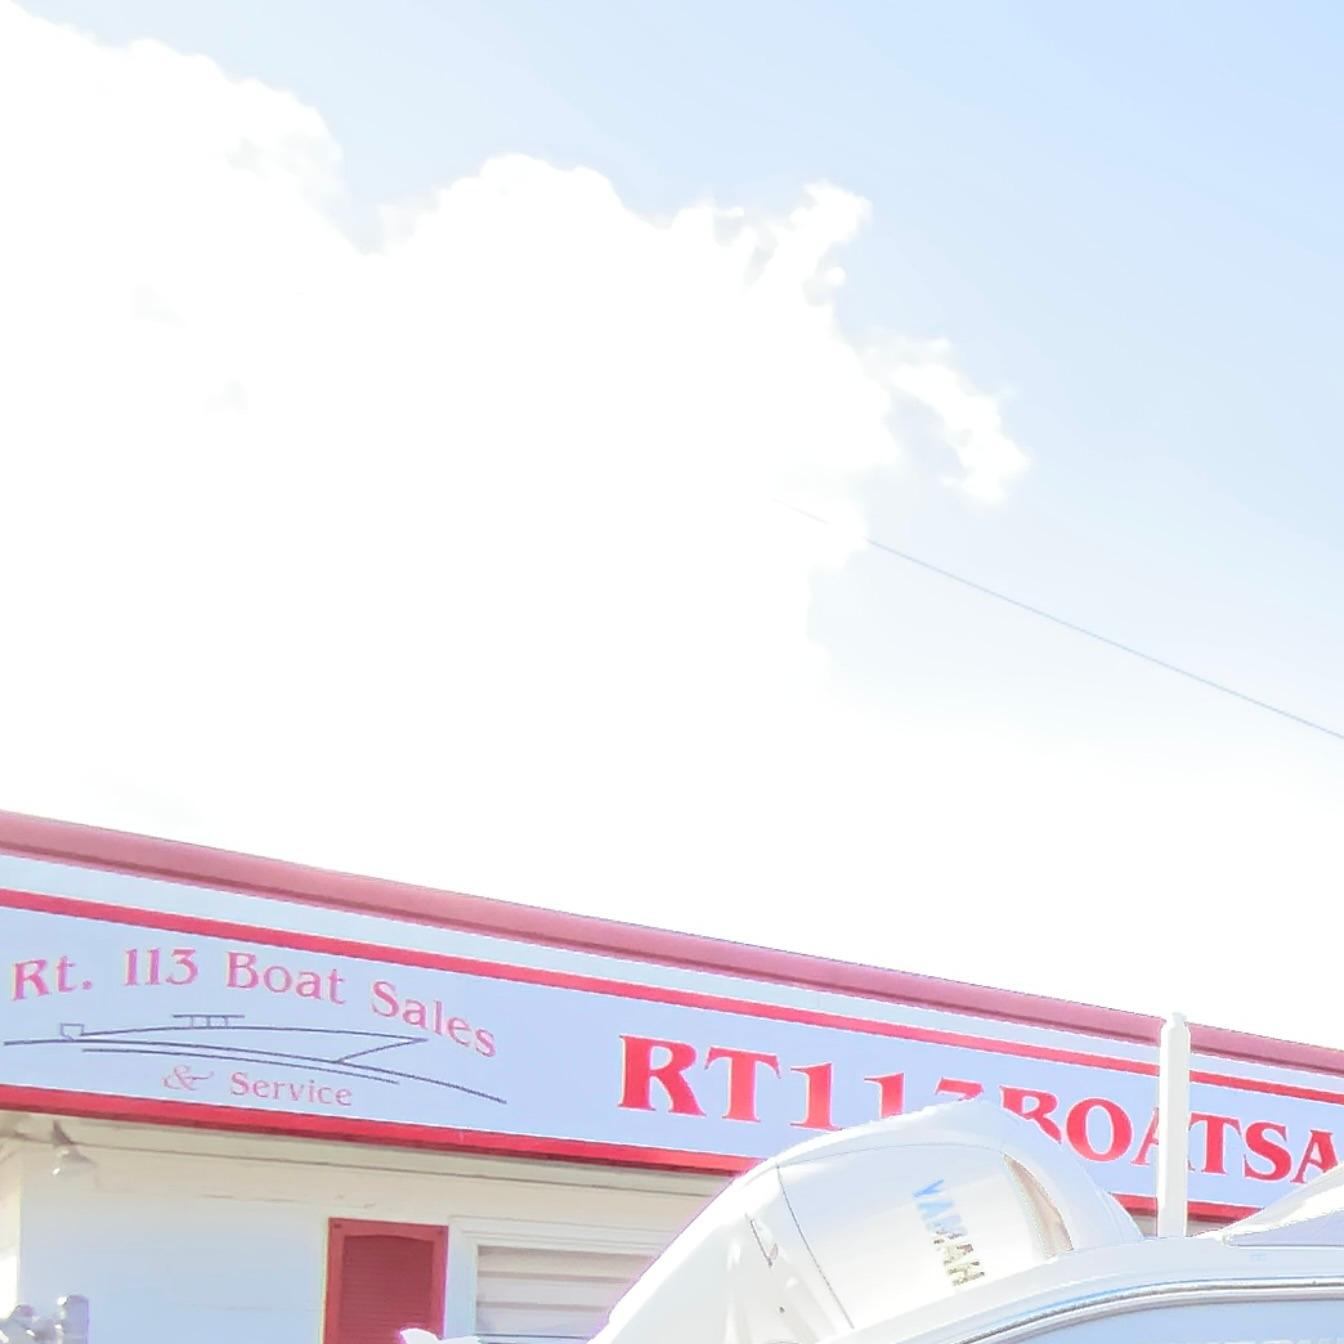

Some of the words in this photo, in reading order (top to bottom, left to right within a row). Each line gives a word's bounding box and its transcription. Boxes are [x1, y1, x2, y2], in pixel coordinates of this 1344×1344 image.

[12, 954, 93, 1000] Rt.
[124, 947, 199, 987] 113
[226, 951, 345, 1005] Boat
[371, 981, 497, 1058] Sales
[161, 1065, 214, 1091] &
[230, 1071, 353, 1107] Service
